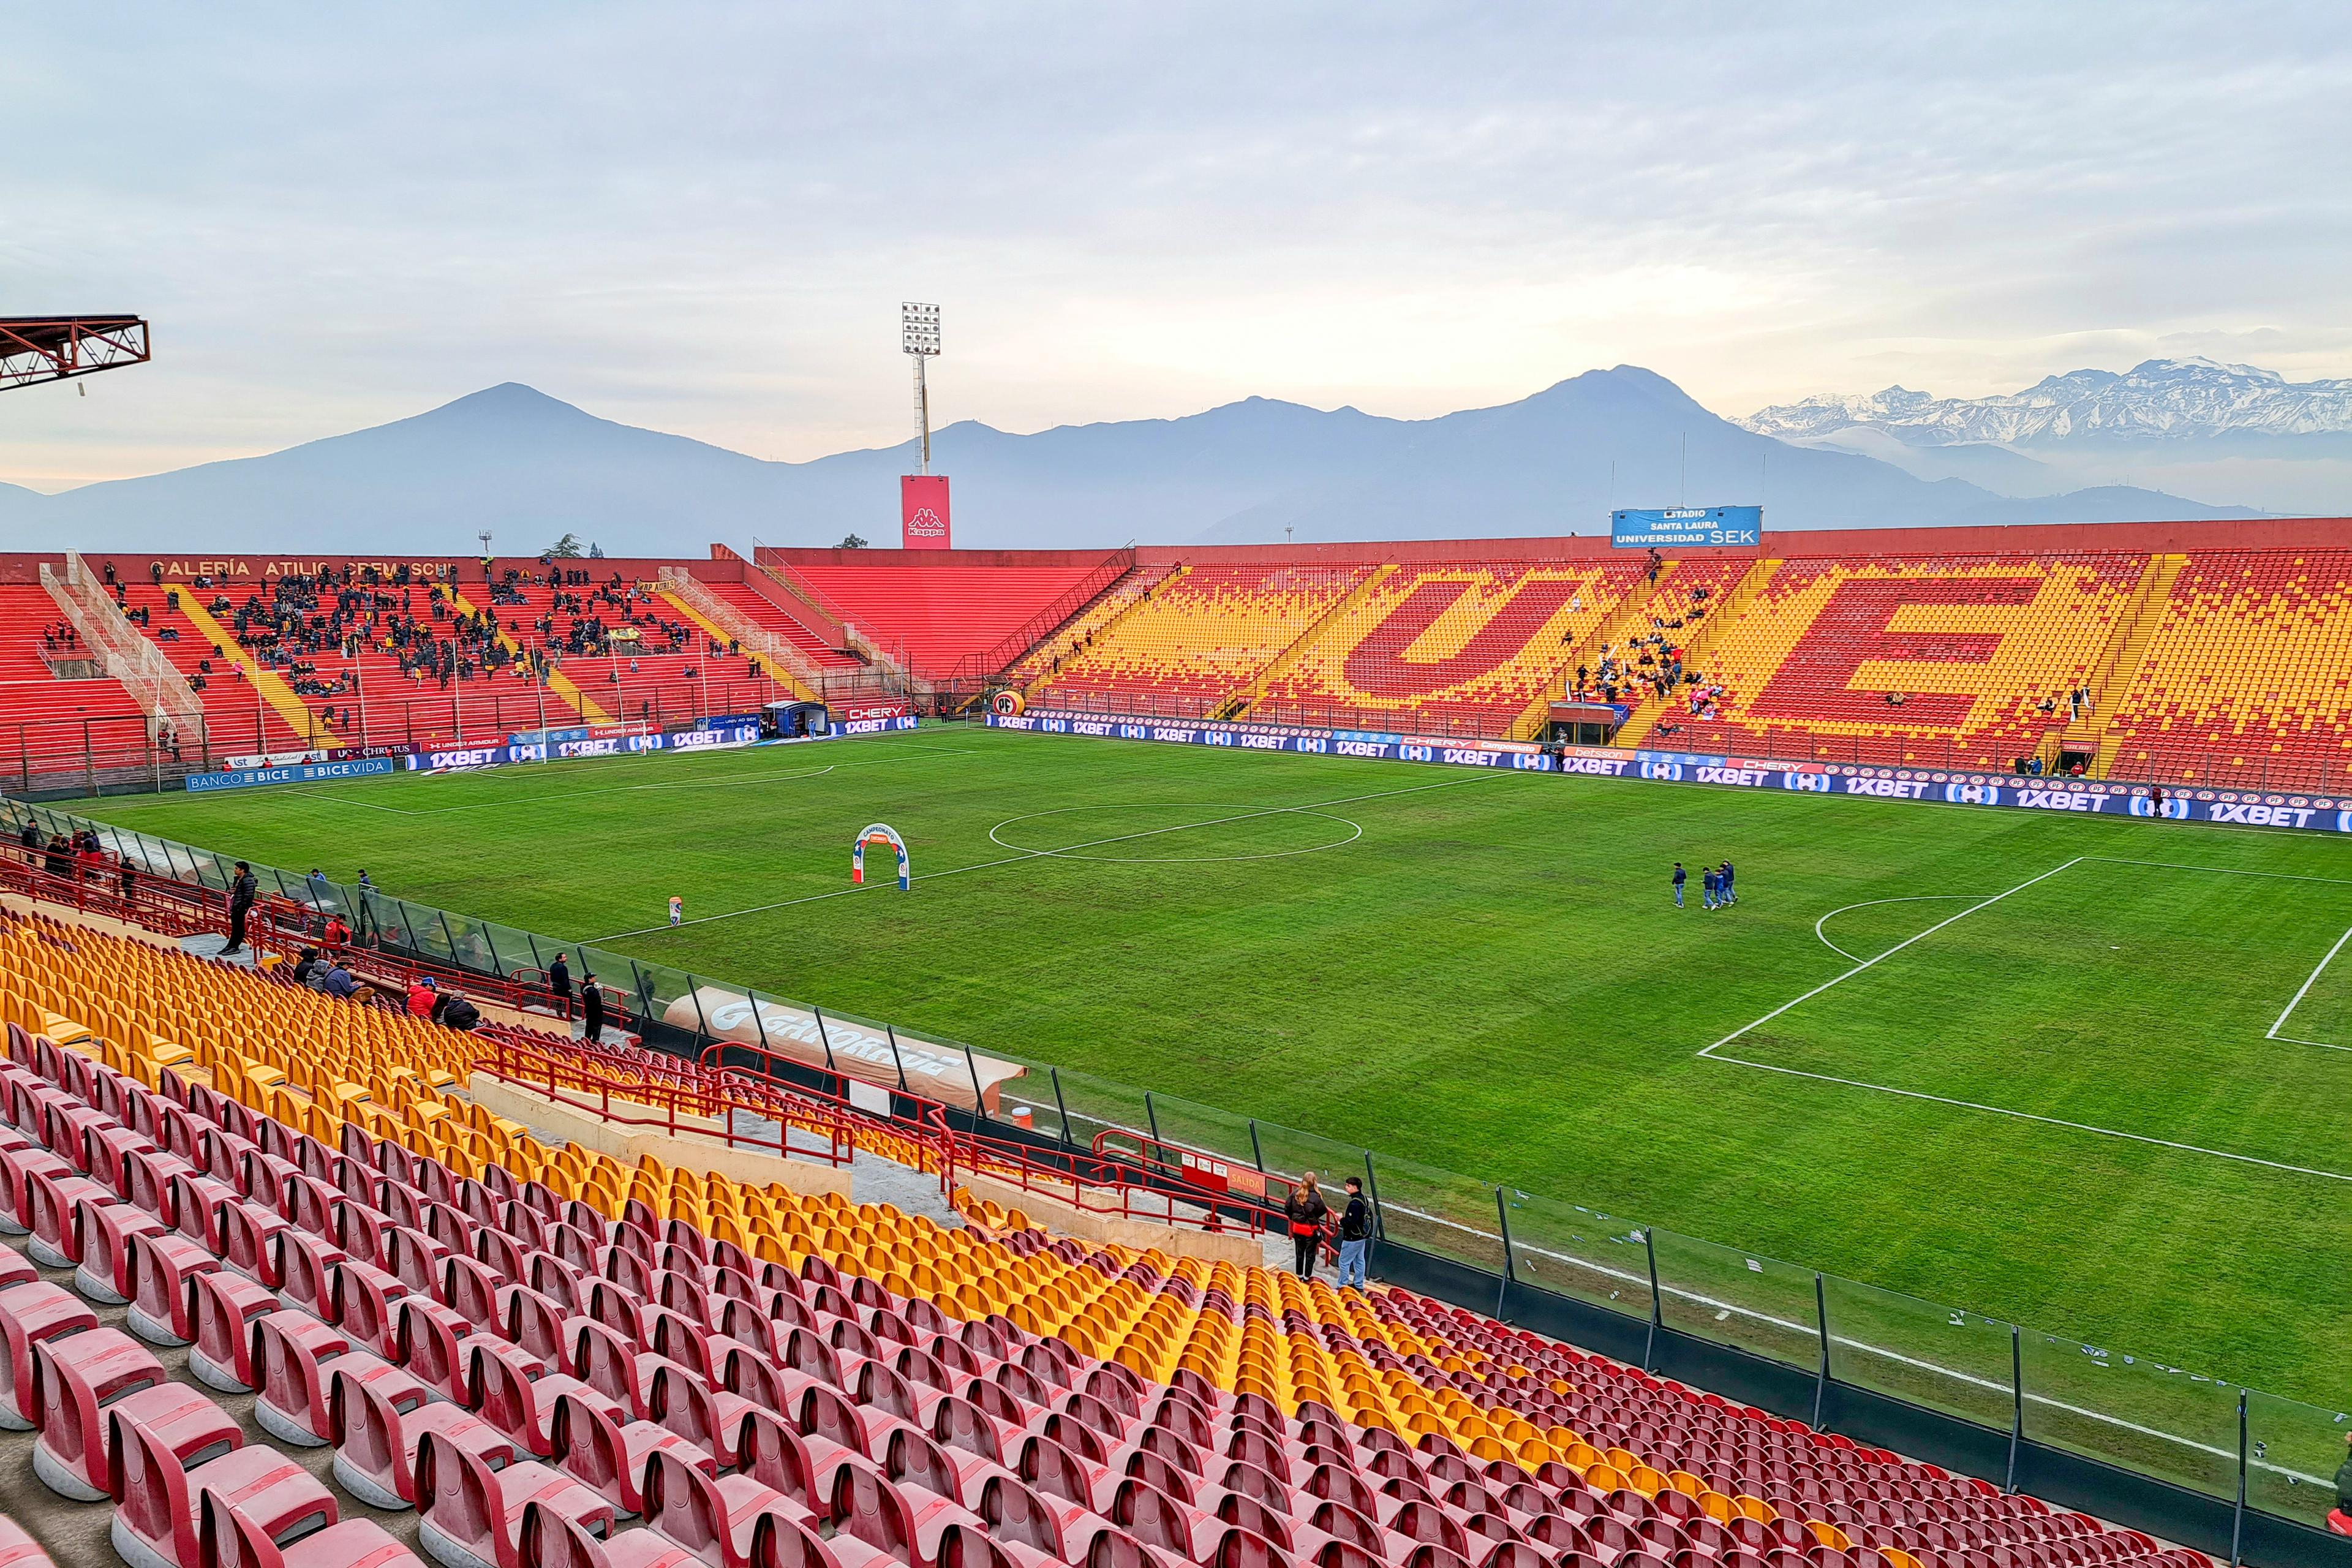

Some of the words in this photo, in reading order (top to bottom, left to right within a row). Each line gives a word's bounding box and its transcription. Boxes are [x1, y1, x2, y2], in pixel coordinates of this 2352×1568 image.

[1664, 510, 1705, 519] ESTADIO
[908, 527, 945, 537] Kappa
[1686, 521, 1718, 530] LAURA
[1616, 533, 1705, 543] UNIVERSIDAD
[1710, 530, 1755, 544] SEK
[149, 558, 251, 576] GALERÍA
[849, 706, 903, 720] CHERY
[845, 718, 888, 734] 1XBET
[998, 716, 1036, 730] 1XBET
[1072, 721, 1113, 736] 1XBET
[672, 729, 725, 747] 1XBET
[1153, 727, 1197, 743] 1XBET
[1240, 734, 1288, 750] 1XBET
[1403, 737, 1471, 747] CHERY
[1336, 741, 1390, 758] 1XBET
[1480, 741, 1536, 752] Campeonato
[1575, 748, 1623, 759] betsson
[430, 748, 497, 768] 1XBET
[1443, 748, 1502, 766] 1XBET
[317, 765, 350, 777] BICE
[352, 761, 385, 774] VIDA
[1562, 756, 1629, 776] 1XBET
[1743, 760, 1804, 772] CHERY
[191, 774, 241, 788] BANCO
[257, 769, 290, 782] BICE
[1695, 766, 1770, 786] 1XBET
[1846, 777, 1929, 799] 1XBET
[2016, 789, 2110, 812] 1XBET
[2209, 802, 2316, 827] 1XBET
[863, 827, 894, 840] CAMPEONATO
[1232, 1174, 1261, 1189] SALIDA
